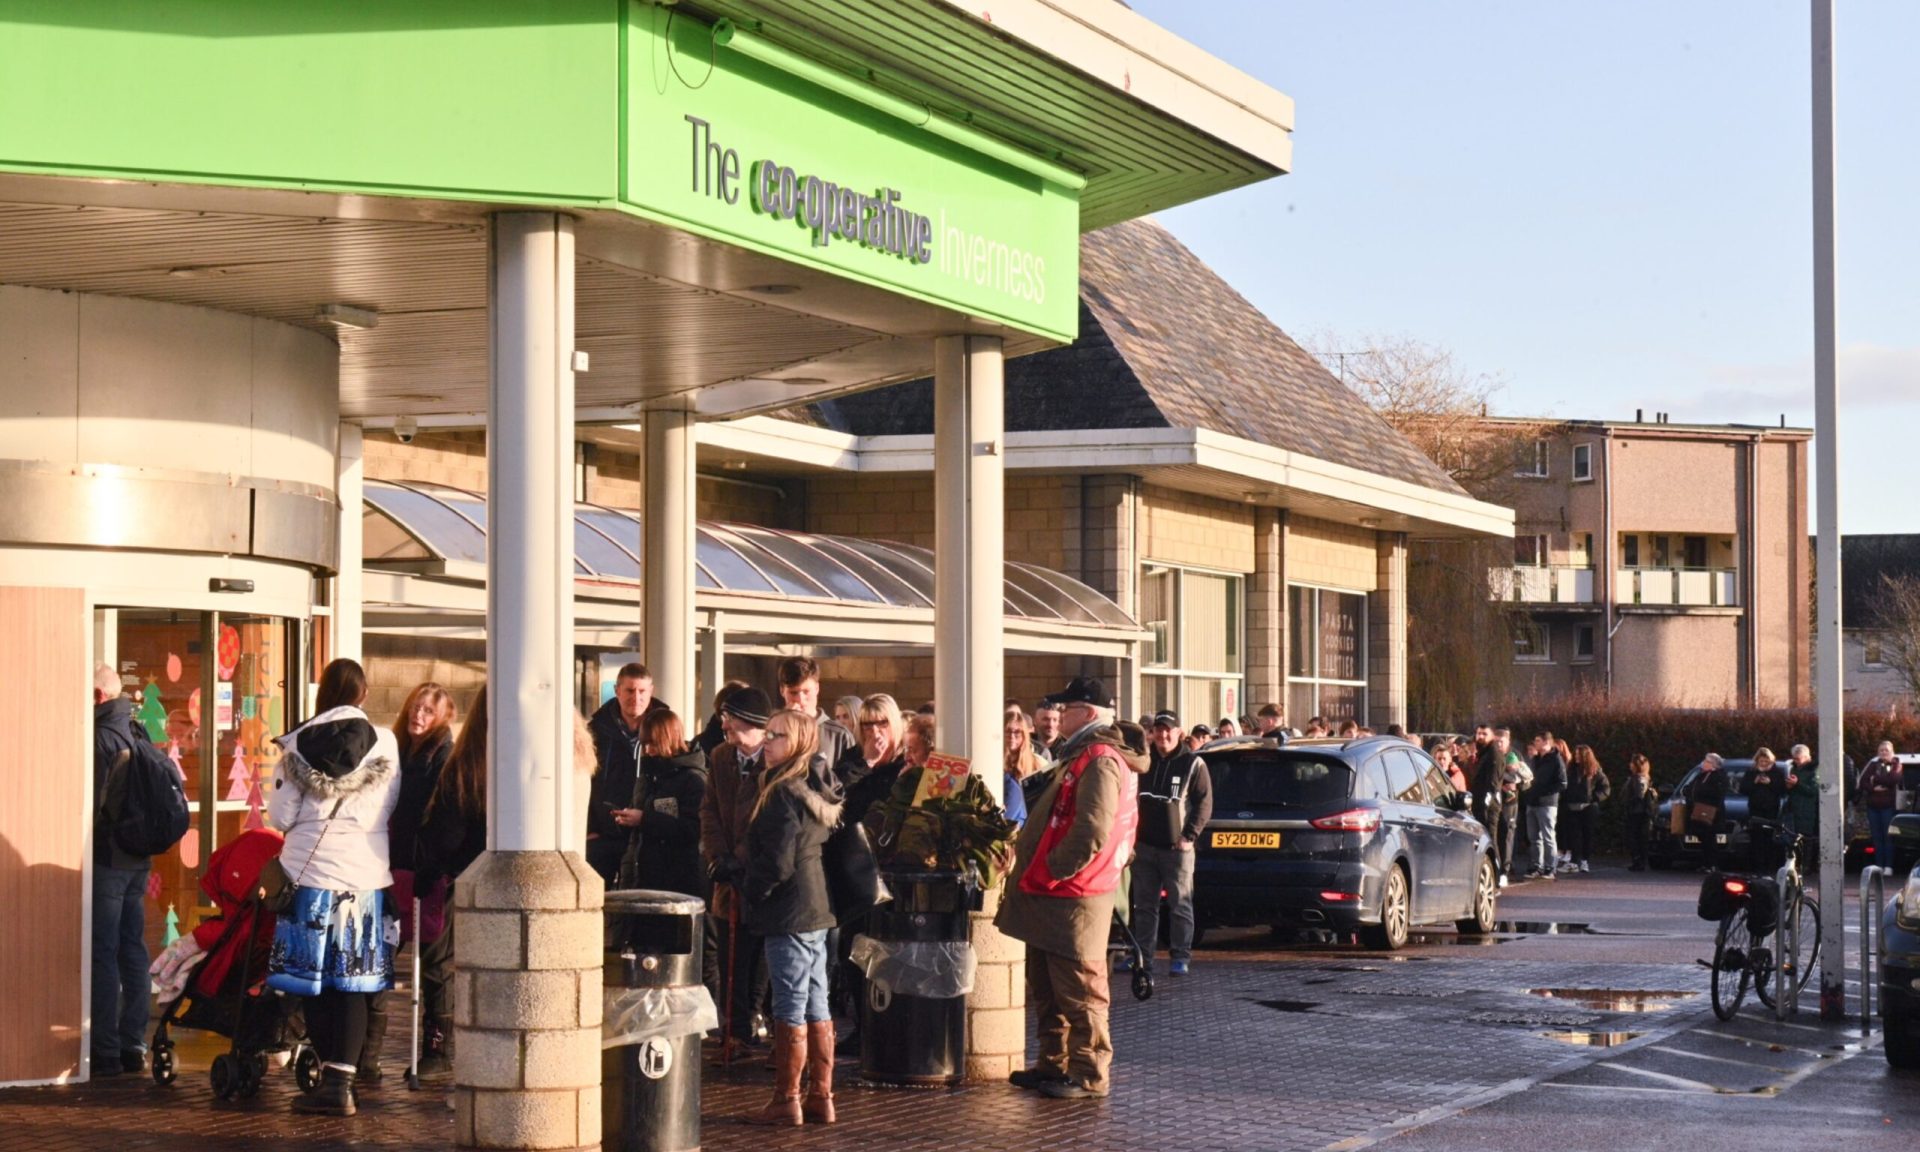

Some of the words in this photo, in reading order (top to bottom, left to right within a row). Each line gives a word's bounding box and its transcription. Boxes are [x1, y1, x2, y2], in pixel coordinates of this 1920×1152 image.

[684, 114, 740, 205] The
[757, 159, 933, 264] co-operative
[939, 207, 1046, 305] Inverness
[1325, 635, 1354, 651] COOKIES
[1216, 833, 1248, 845] SY20
[1250, 834, 1274, 846] OWG
